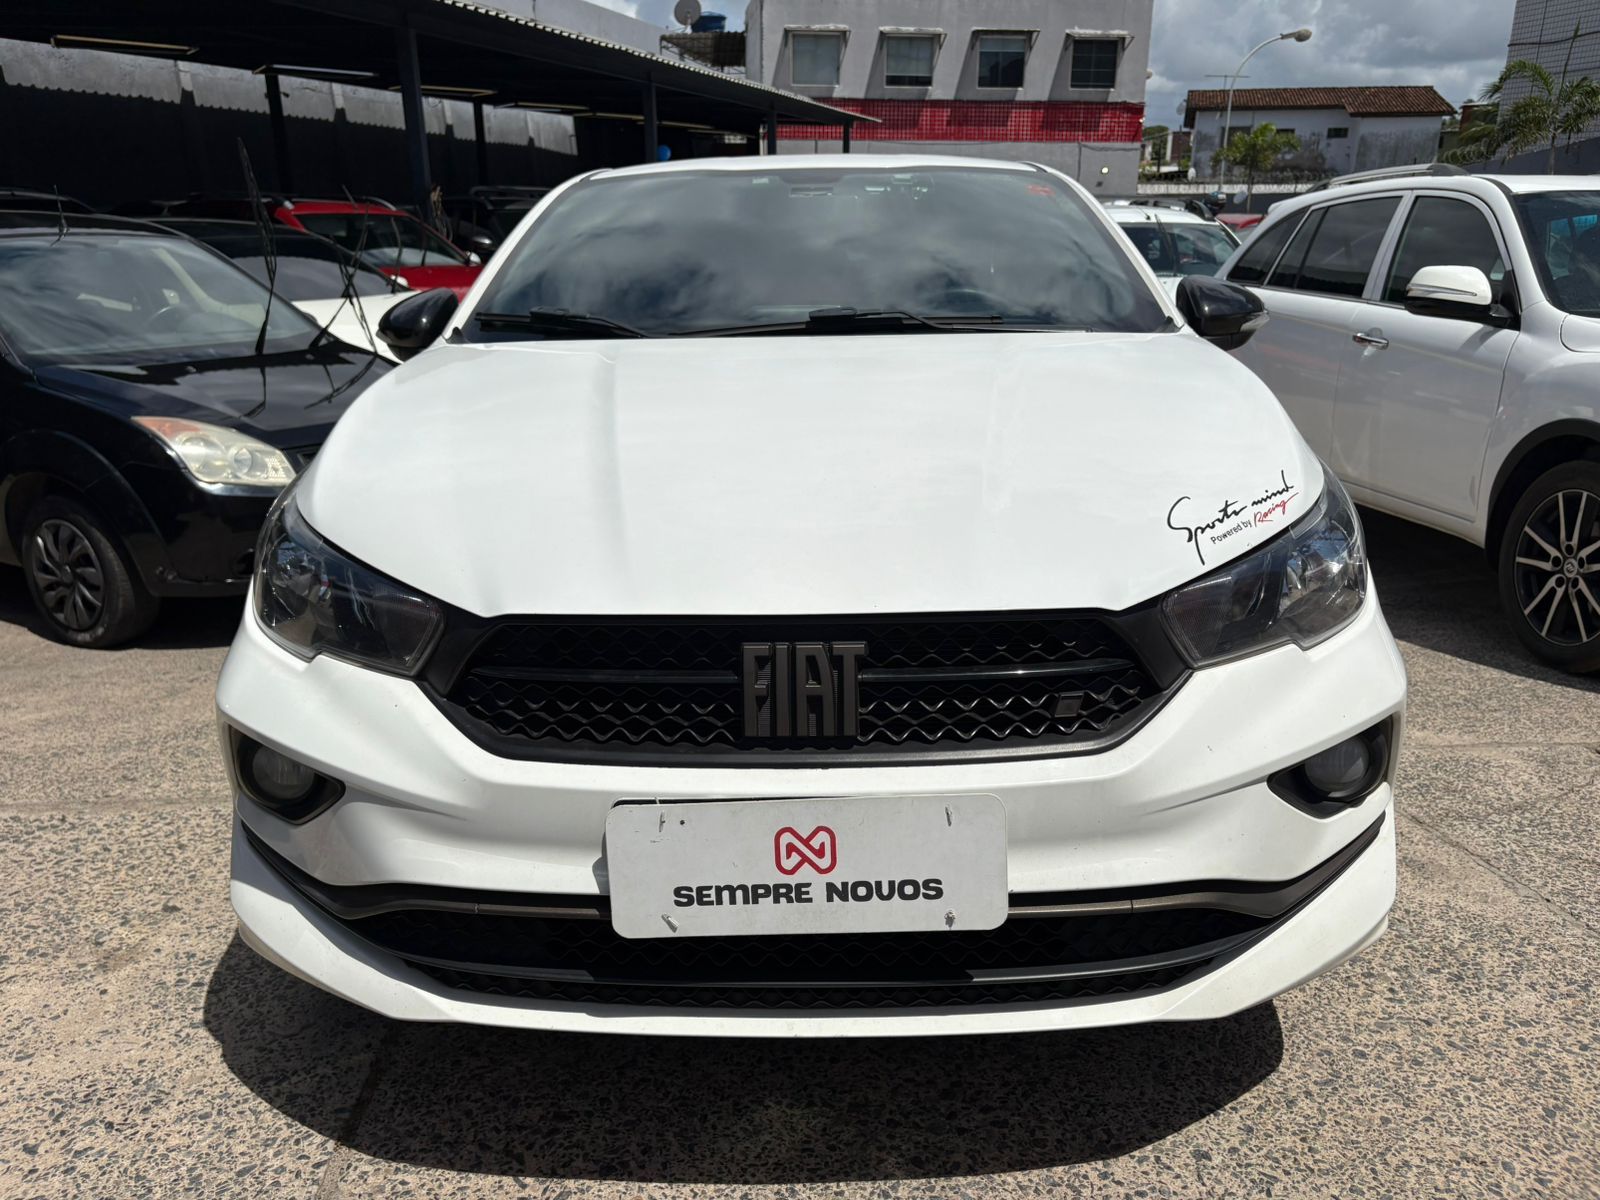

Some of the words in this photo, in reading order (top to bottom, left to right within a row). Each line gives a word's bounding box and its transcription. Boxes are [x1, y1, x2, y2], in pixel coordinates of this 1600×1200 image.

[1210, 523, 1243, 544] Powered
[1241, 519, 1252, 528] by
[1253, 492, 1299, 527] Racing
[742, 641, 867, 737] FIAT
[673, 882, 813, 907] SEMPRE
[825, 878, 944, 902] NOVOS
